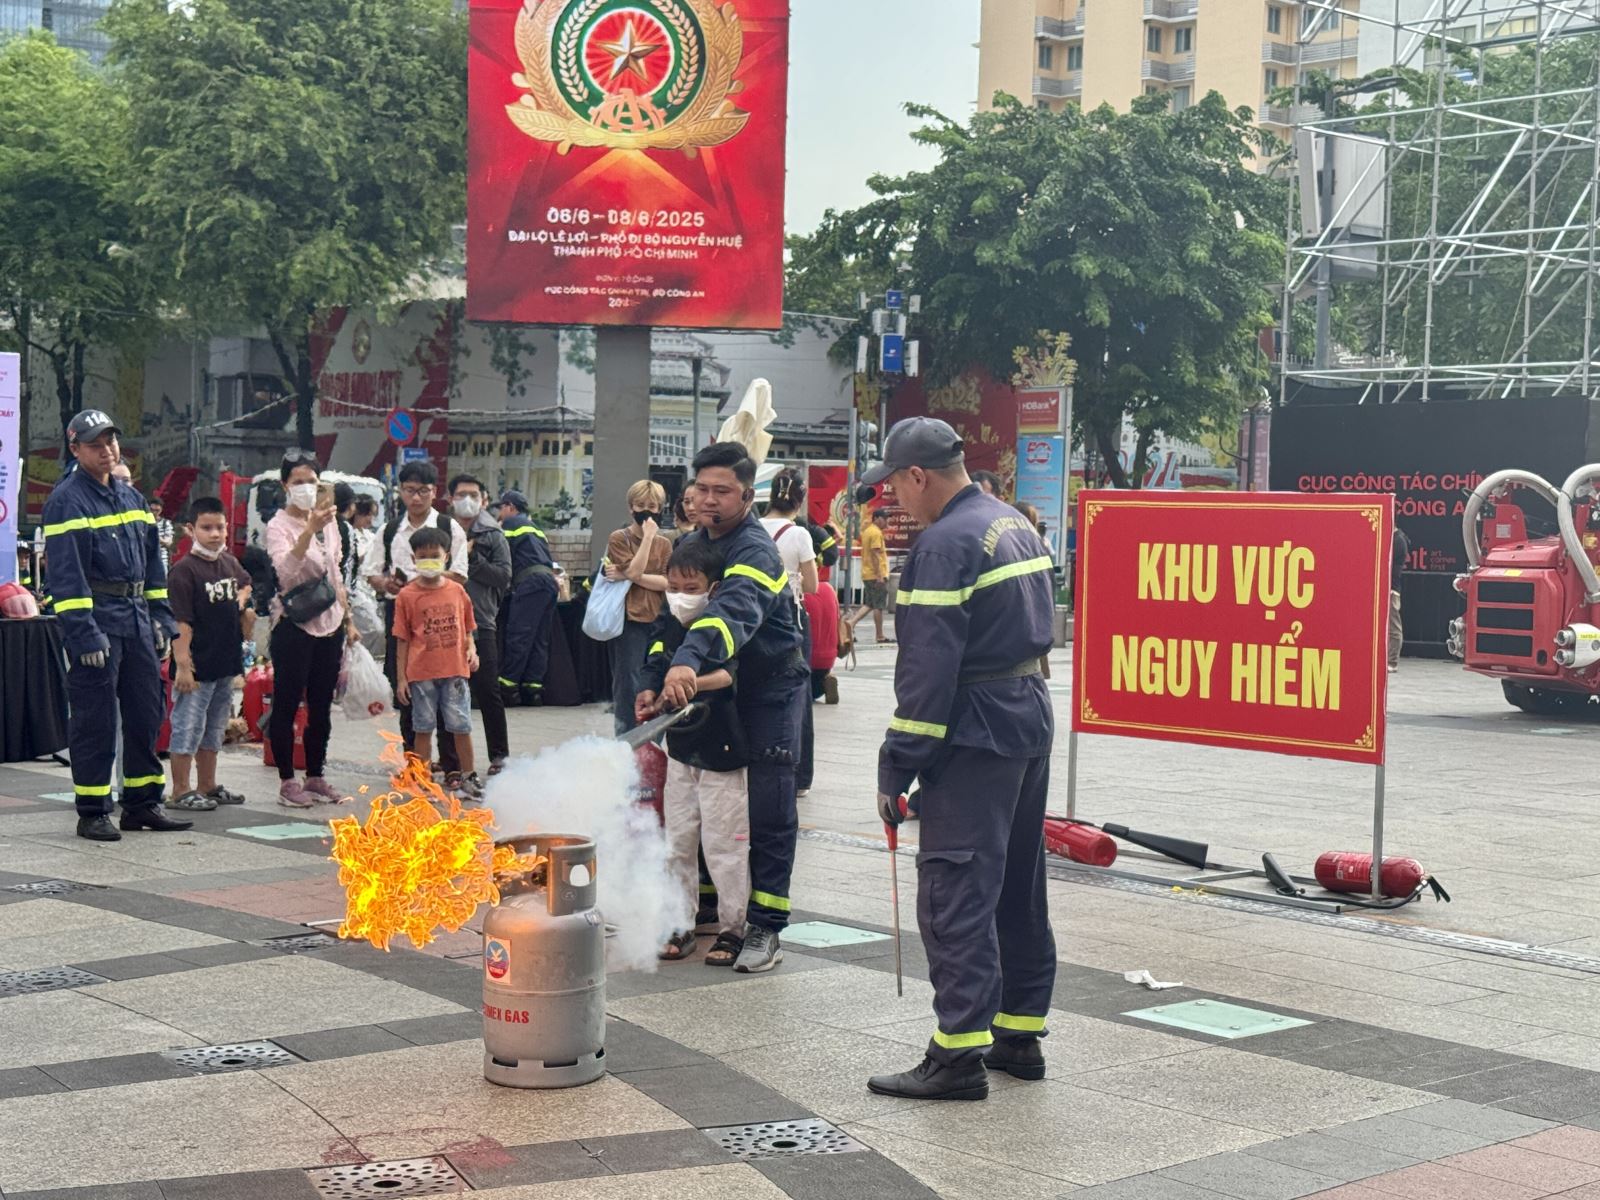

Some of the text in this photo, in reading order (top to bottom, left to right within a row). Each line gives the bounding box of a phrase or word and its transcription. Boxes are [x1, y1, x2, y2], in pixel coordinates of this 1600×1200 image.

[1022, 401, 1050, 411] HDBank
[85, 411, 110, 427] 114
[1340, 472, 1396, 491] CÔNG
[1400, 471, 1437, 490] TÁC
[1137, 540, 1316, 621] KHU VỰC
[1111, 620, 1342, 711] NGUY HIỂM
[504, 1009, 530, 1024] GAS
